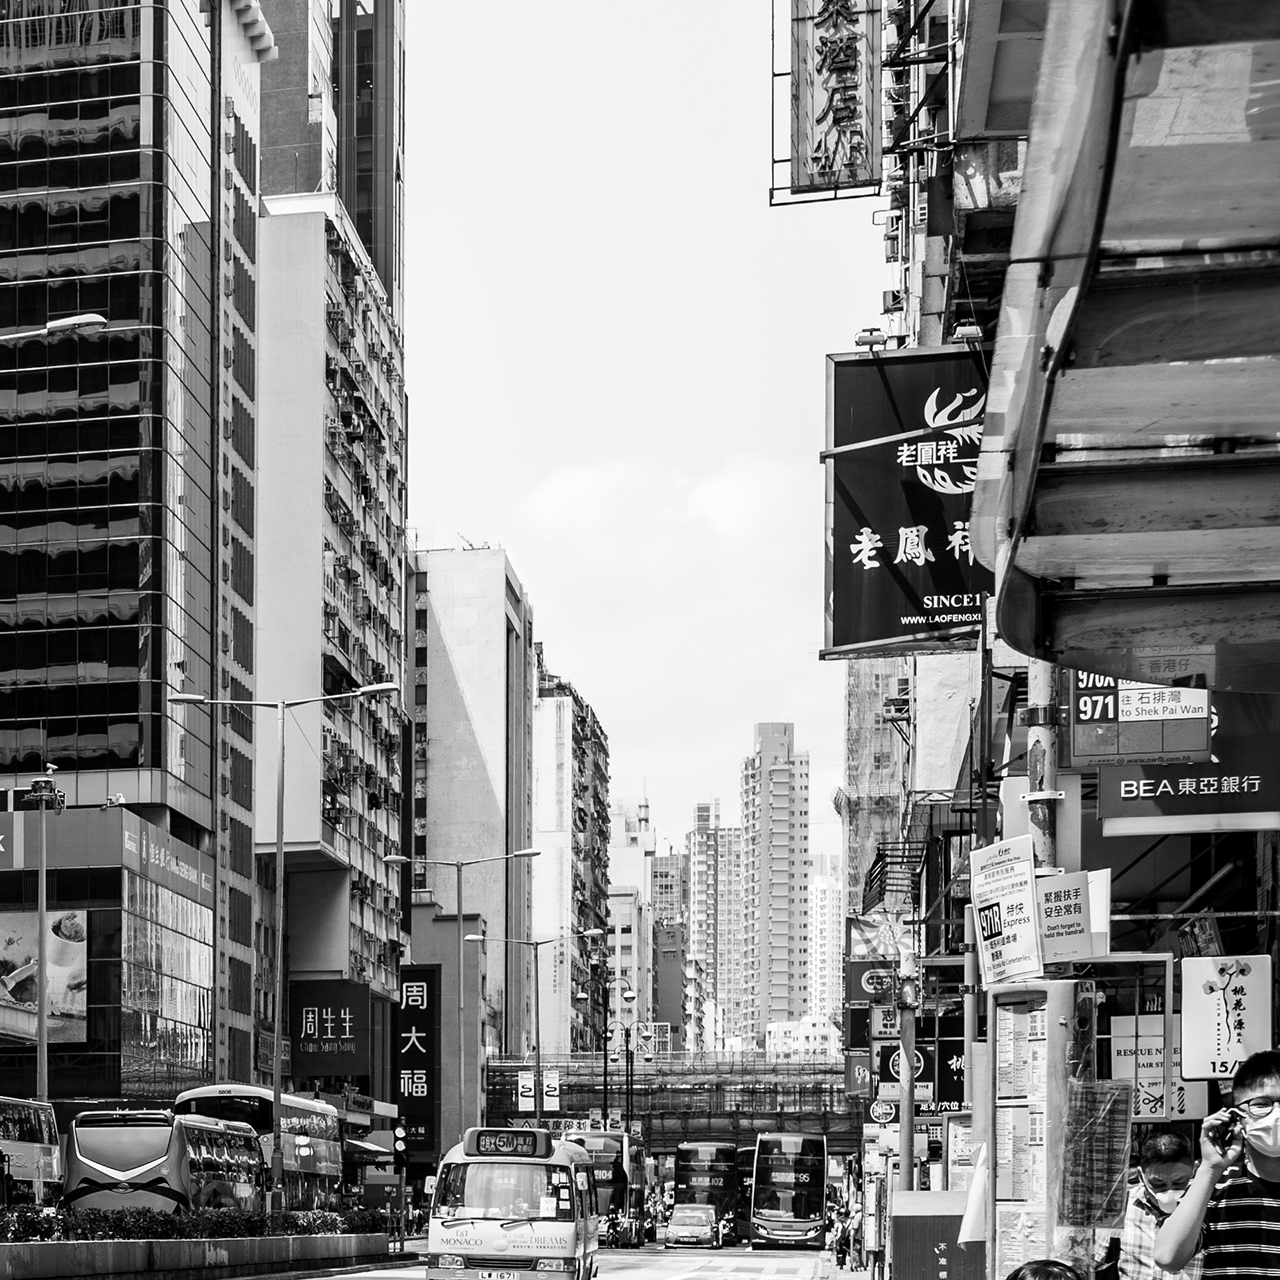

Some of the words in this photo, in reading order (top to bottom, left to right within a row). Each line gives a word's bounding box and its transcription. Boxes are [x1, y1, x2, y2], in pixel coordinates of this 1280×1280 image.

[896, 440, 959, 467] 老鳳祥
[1078, 694, 1114, 720] 971
[1137, 690, 1182, 705] 石排灣
[1121, 708, 1132, 717] to
[1135, 705, 1160, 717] Shek
[1162, 705, 1178, 716] Pai
[1179, 703, 1204, 715] Wan
[1120, 779, 1175, 798] BEA
[1178, 775, 1261, 797] 東亞銀行
[1044, 888, 1082, 904] 緊握扶手
[1006, 902, 1024, 917] 特快
[1044, 903, 1082, 919] 安全常有
[980, 905, 1001, 938] 971R
[1003, 915, 1031, 929] Express
[1061, 922, 1076, 930] forget
[1044, 931, 1056, 939] hold
[1056, 930, 1064, 938] the
[1064, 928, 1085, 936] handrail
[300, 1007, 354, 1039] 周生生
[399, 982, 427, 1098] 周大福
[320, 1041, 339, 1054] Sang
[338, 1041, 356, 1054] Sang
[497, 1136, 515, 1148] 5M
[441, 1237, 483, 1247] MONACO
[529, 1236, 568, 1245] DREAMS
[496, 1271, 516, 1280] 1671
